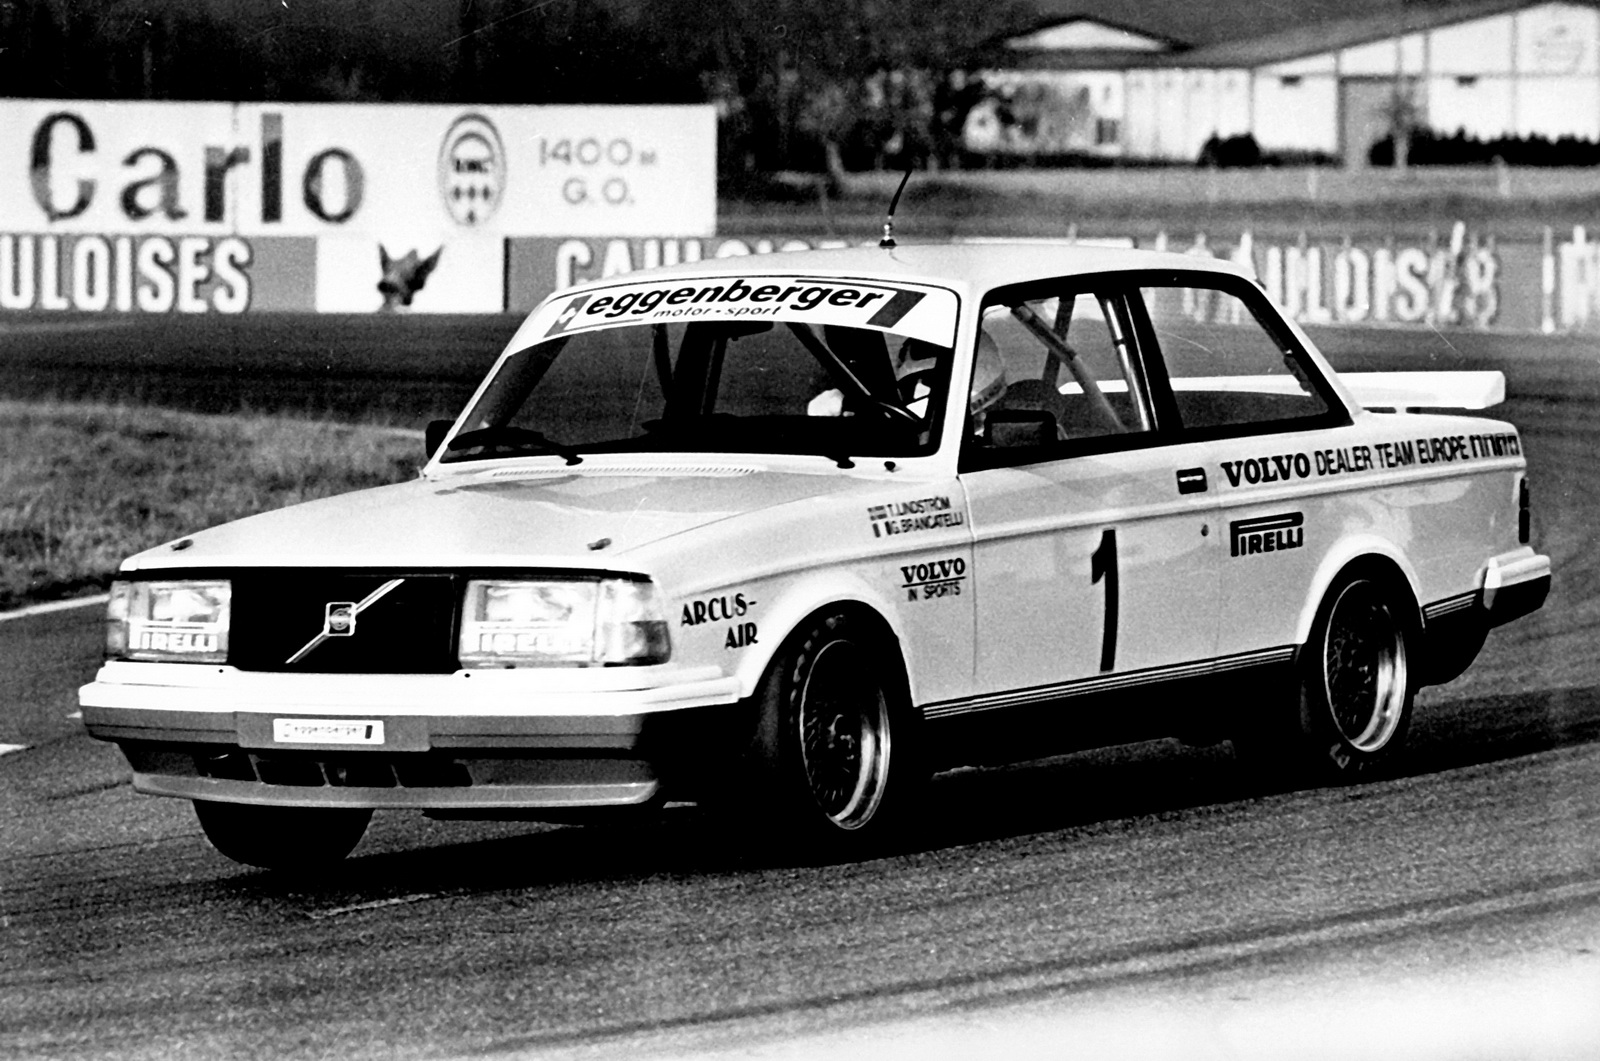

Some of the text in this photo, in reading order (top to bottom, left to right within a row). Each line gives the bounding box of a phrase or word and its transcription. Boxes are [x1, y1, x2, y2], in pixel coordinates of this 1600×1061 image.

[30, 112, 365, 223] Carlo
[539, 137, 633, 167] 1400
[586, 279, 885, 319] eggenberger
[727, 305, 782, 317] sport
[1221, 452, 1311, 488] VOLVO
[1314, 445, 1375, 476] DEALER
[1375, 440, 1415, 469] TEAM
[1416, 435, 1469, 464] EUROPE
[1230, 511, 1304, 557] PIRELLI
[900, 558, 966, 584] VOLVO
[923, 581, 961, 600] SPORTS
[1091, 528, 1119, 673] 1
[681, 592, 757, 627] ARCUS-
[463, 618, 592, 652] PIRE
[724, 621, 759, 650] AIR
